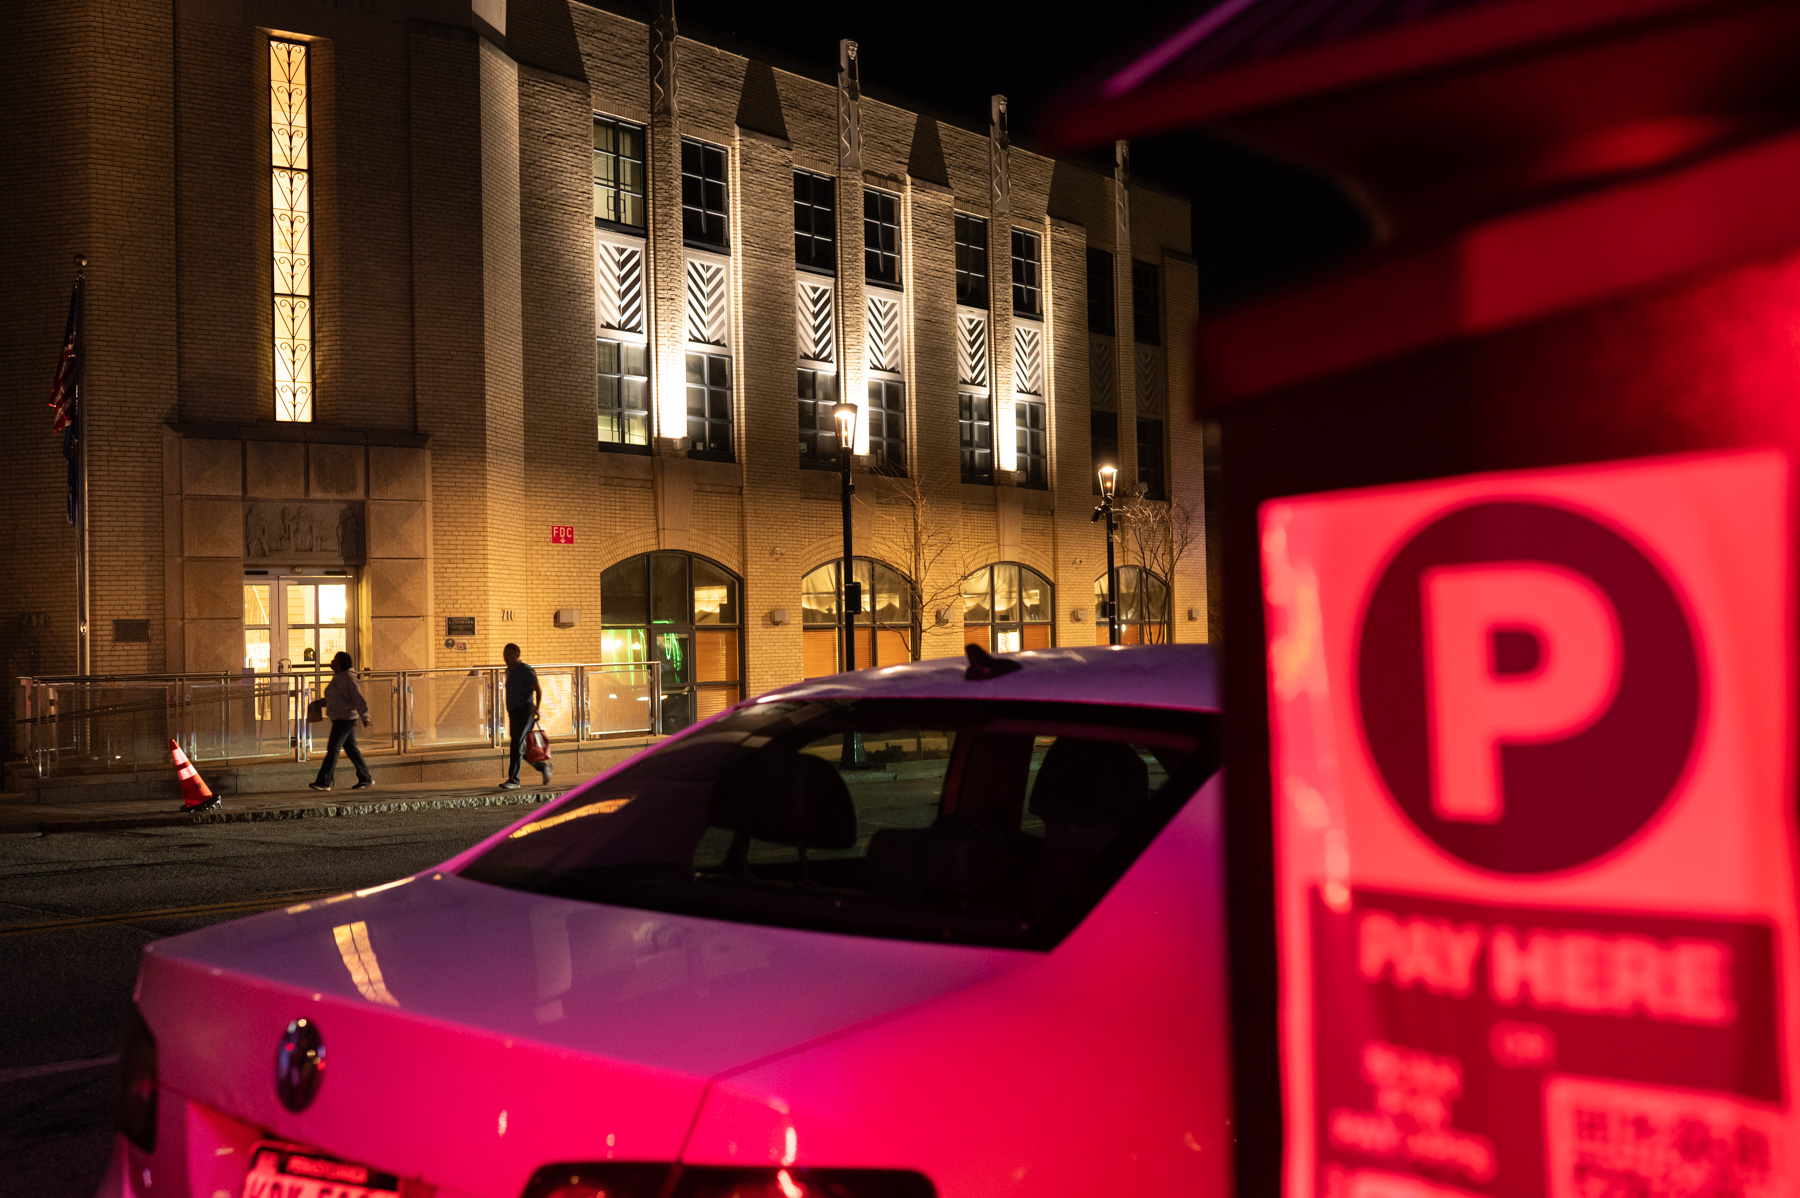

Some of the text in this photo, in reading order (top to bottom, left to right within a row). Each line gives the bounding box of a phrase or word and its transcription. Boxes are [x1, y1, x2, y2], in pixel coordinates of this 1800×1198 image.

[553, 526, 572, 538] FDC
[1423, 560, 1624, 823] P
[1358, 912, 1730, 1022] PAY HERE
